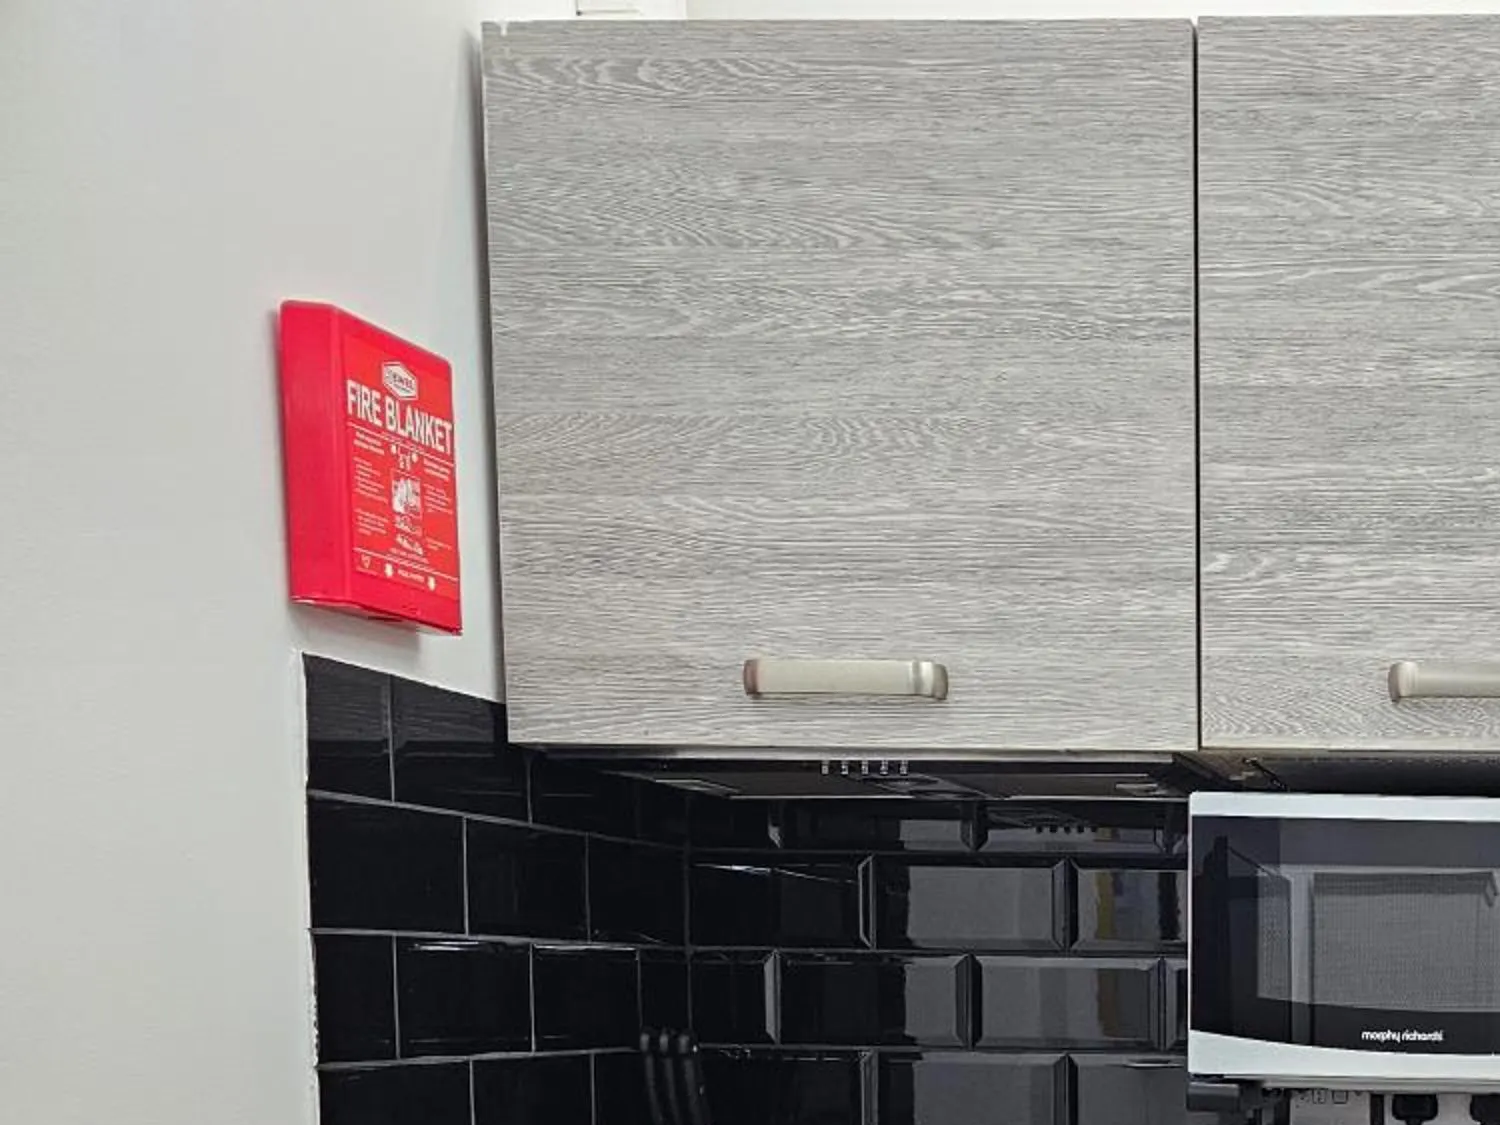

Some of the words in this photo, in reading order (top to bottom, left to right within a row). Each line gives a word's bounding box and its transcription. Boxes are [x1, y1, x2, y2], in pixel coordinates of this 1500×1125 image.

[346, 378, 383, 427] FIRE
[385, 395, 453, 455] BLANKET
[1361, 1028, 1400, 1043] morphy
